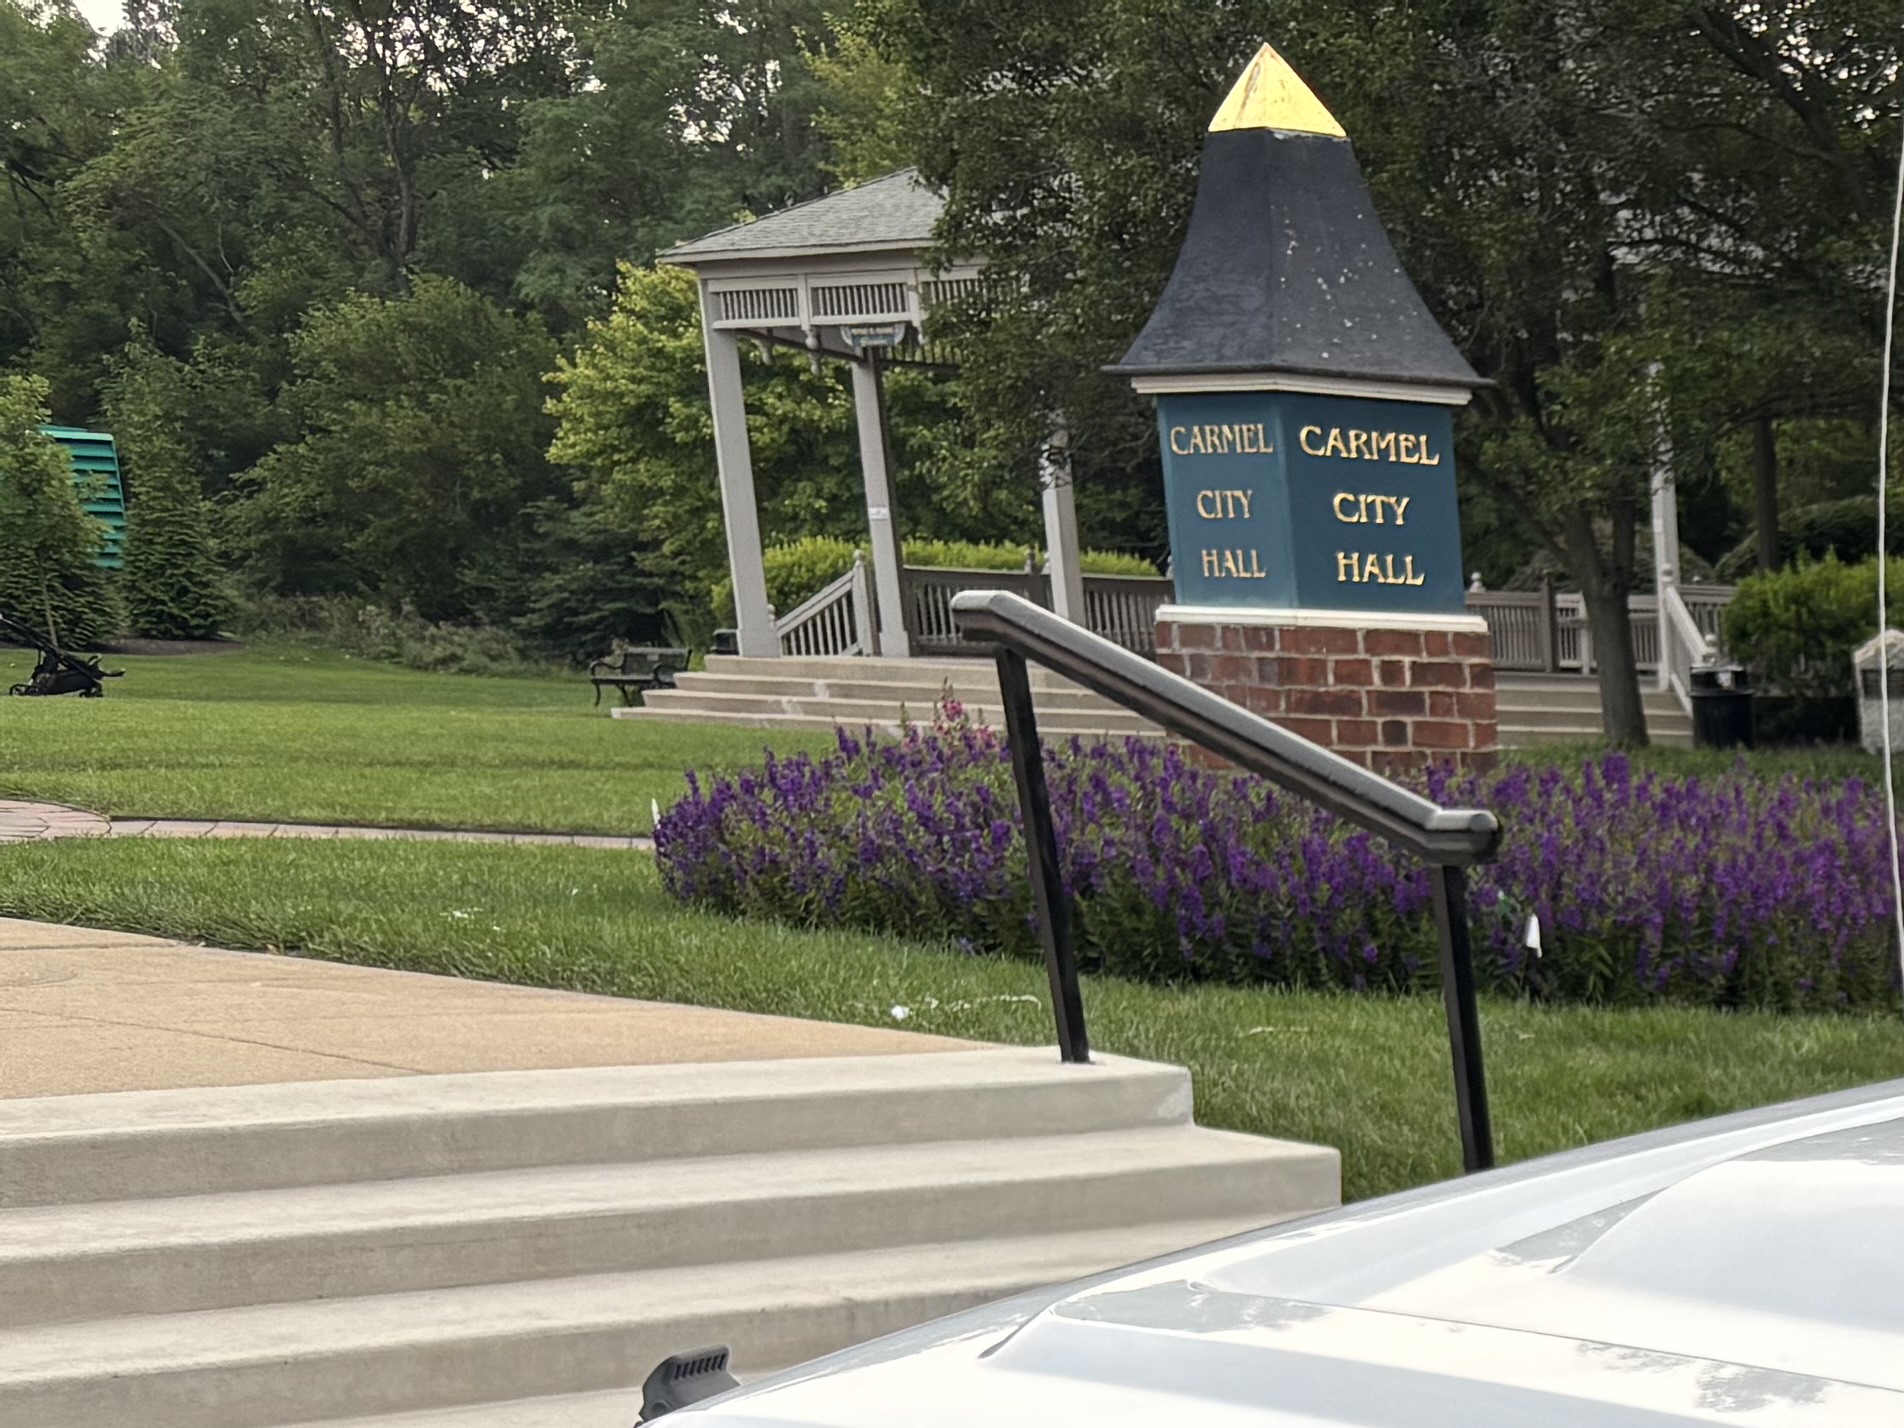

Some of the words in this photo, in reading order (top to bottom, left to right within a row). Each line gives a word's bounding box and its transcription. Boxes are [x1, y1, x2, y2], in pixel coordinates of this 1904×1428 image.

[1170, 423, 1273, 456] CARMEL
[1300, 425, 1441, 466] CARMEL
[1196, 489, 1253, 520] CITY
[1332, 492, 1411, 526] CITY
[1201, 549, 1267, 579] HALL
[1335, 551, 1425, 587] HALL
